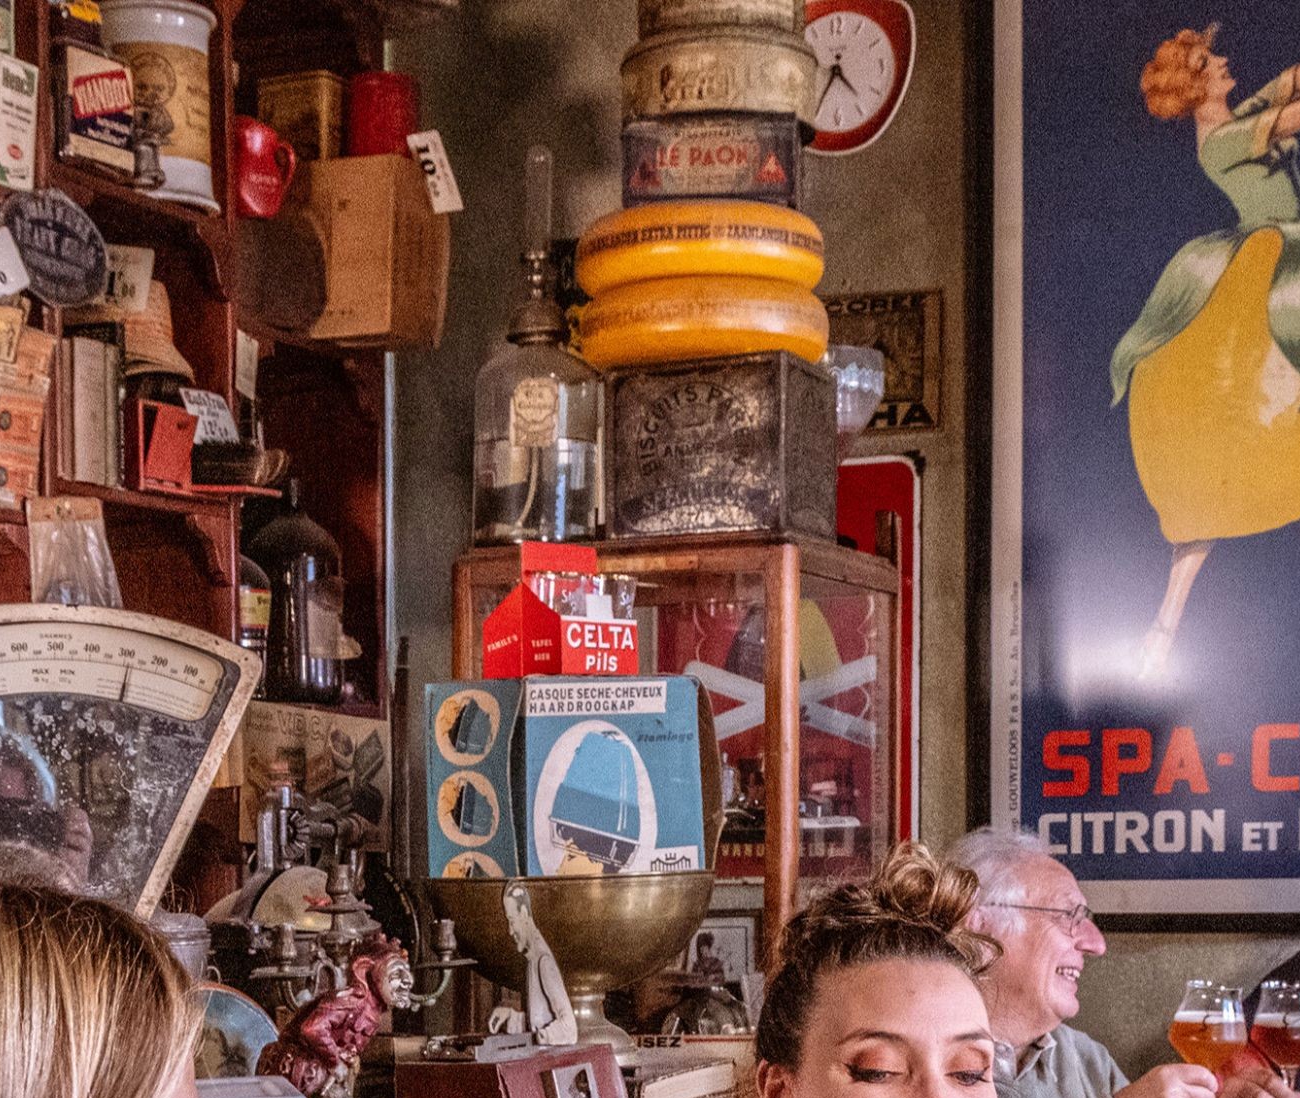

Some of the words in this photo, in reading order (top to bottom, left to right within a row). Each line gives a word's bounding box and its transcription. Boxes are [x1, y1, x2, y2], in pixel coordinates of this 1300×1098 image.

[830, 16, 842, 34] 12
[567, 623, 635, 650] CELTA
[11, 642, 29, 652] 600
[47, 641, 65, 651] 500
[83, 643, 101, 653] 400
[118, 647, 135, 659] 300
[151, 655, 168, 667] 200
[183, 664, 199, 677] 100
[529, 700, 635, 714] HAARDROOGKAP
[530, 688, 574, 701] CASQUE
[576, 686, 663, 700] SECHE-CHEVEUX
[1009, 729, 1019, 811] GOUWELOOS
[1038, 808, 1226, 857] CITRON
[1242, 822, 1283, 852] ET
